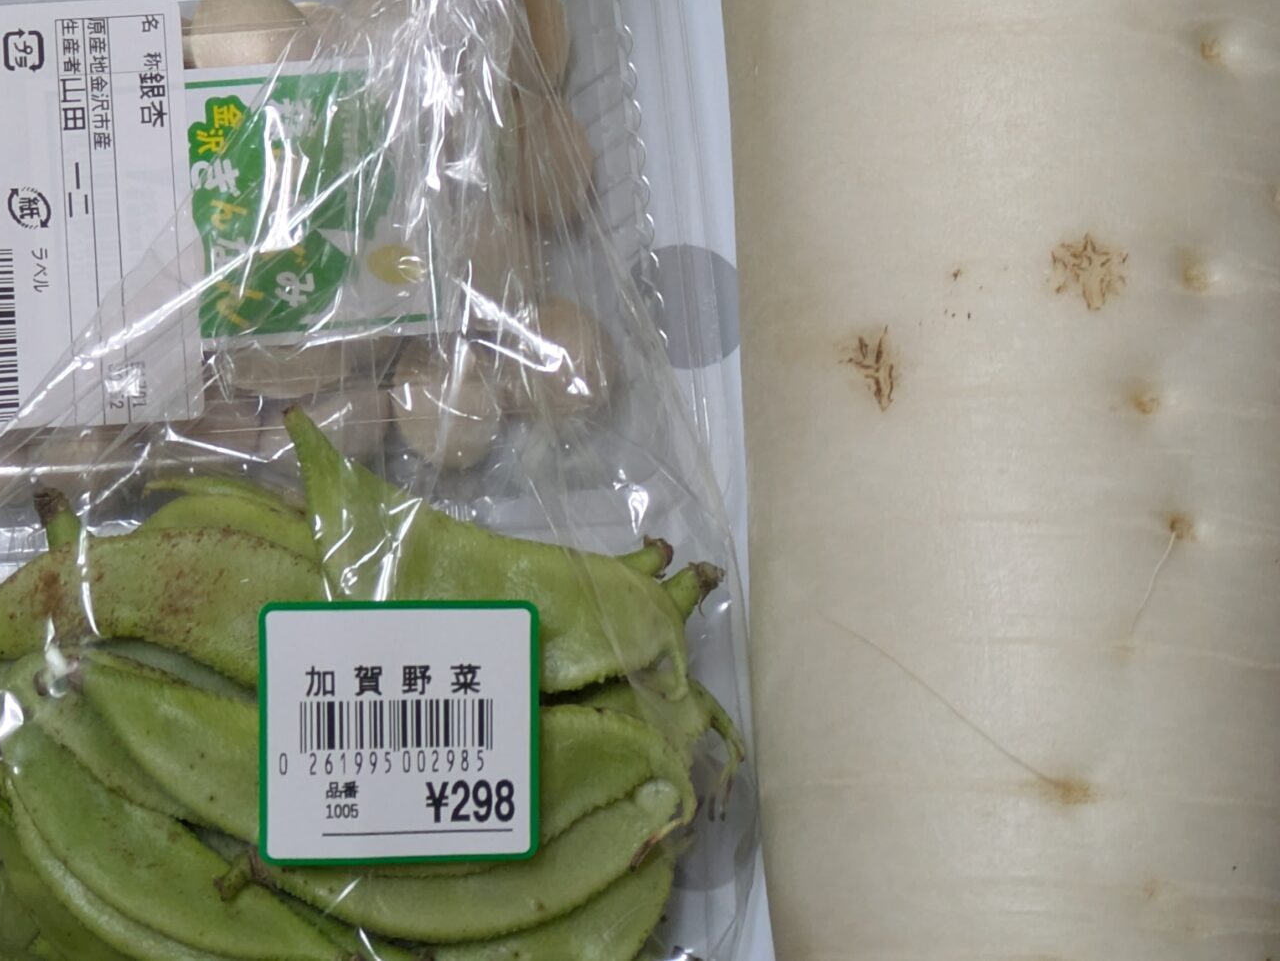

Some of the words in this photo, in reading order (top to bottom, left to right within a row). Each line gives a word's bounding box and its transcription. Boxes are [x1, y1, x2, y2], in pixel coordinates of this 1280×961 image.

[138, 72, 167, 128] 銀杏
[19, 195, 40, 220] 紙
[31, 247, 49, 293] ラベル
[305, 663, 483, 697] 加賀野菜
[325, 780, 360, 800] 品番
[425, 778, 516, 824] ¥298
[325, 803, 360, 819] 1005
